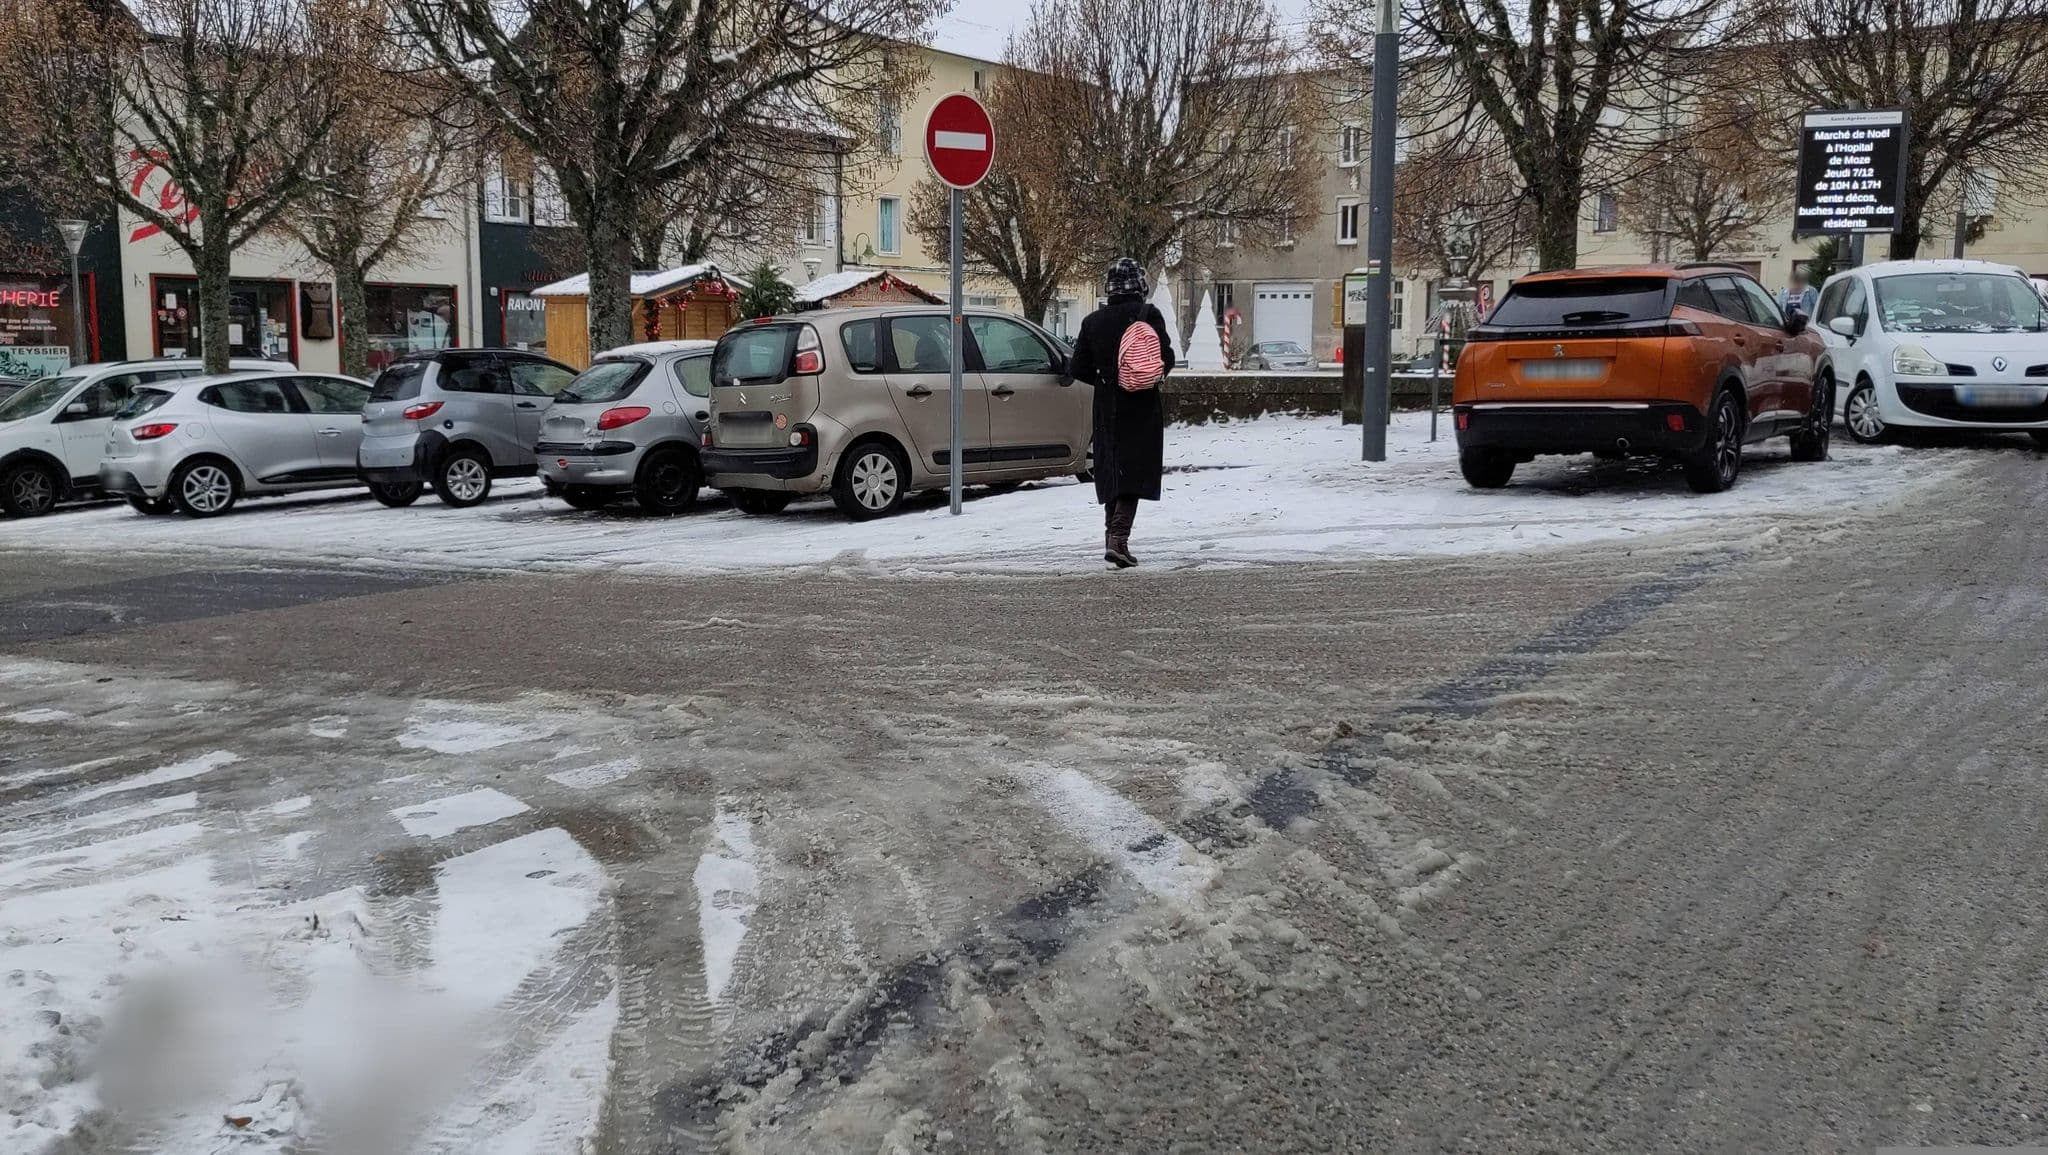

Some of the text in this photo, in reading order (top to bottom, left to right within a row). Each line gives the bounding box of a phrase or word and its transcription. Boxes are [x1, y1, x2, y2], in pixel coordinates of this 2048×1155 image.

[1814, 128, 1890, 140] Marché de Noël
[1829, 156, 1842, 165] de
[1824, 168, 1874, 178] Jeudi 7/12
[1815, 181, 1828, 191] de
[1830, 181, 1850, 190] 10H
[1861, 180, 1881, 189] 17H
[1817, 194, 1843, 203] vente
[1799, 205, 1894, 216] buches au profit des
[1823, 218, 1867, 228] résidents
[0, 291, 60, 307] HERIE
[508, 298, 540, 311] RAYON
[10, 347, 67, 355] TEYSSIER
